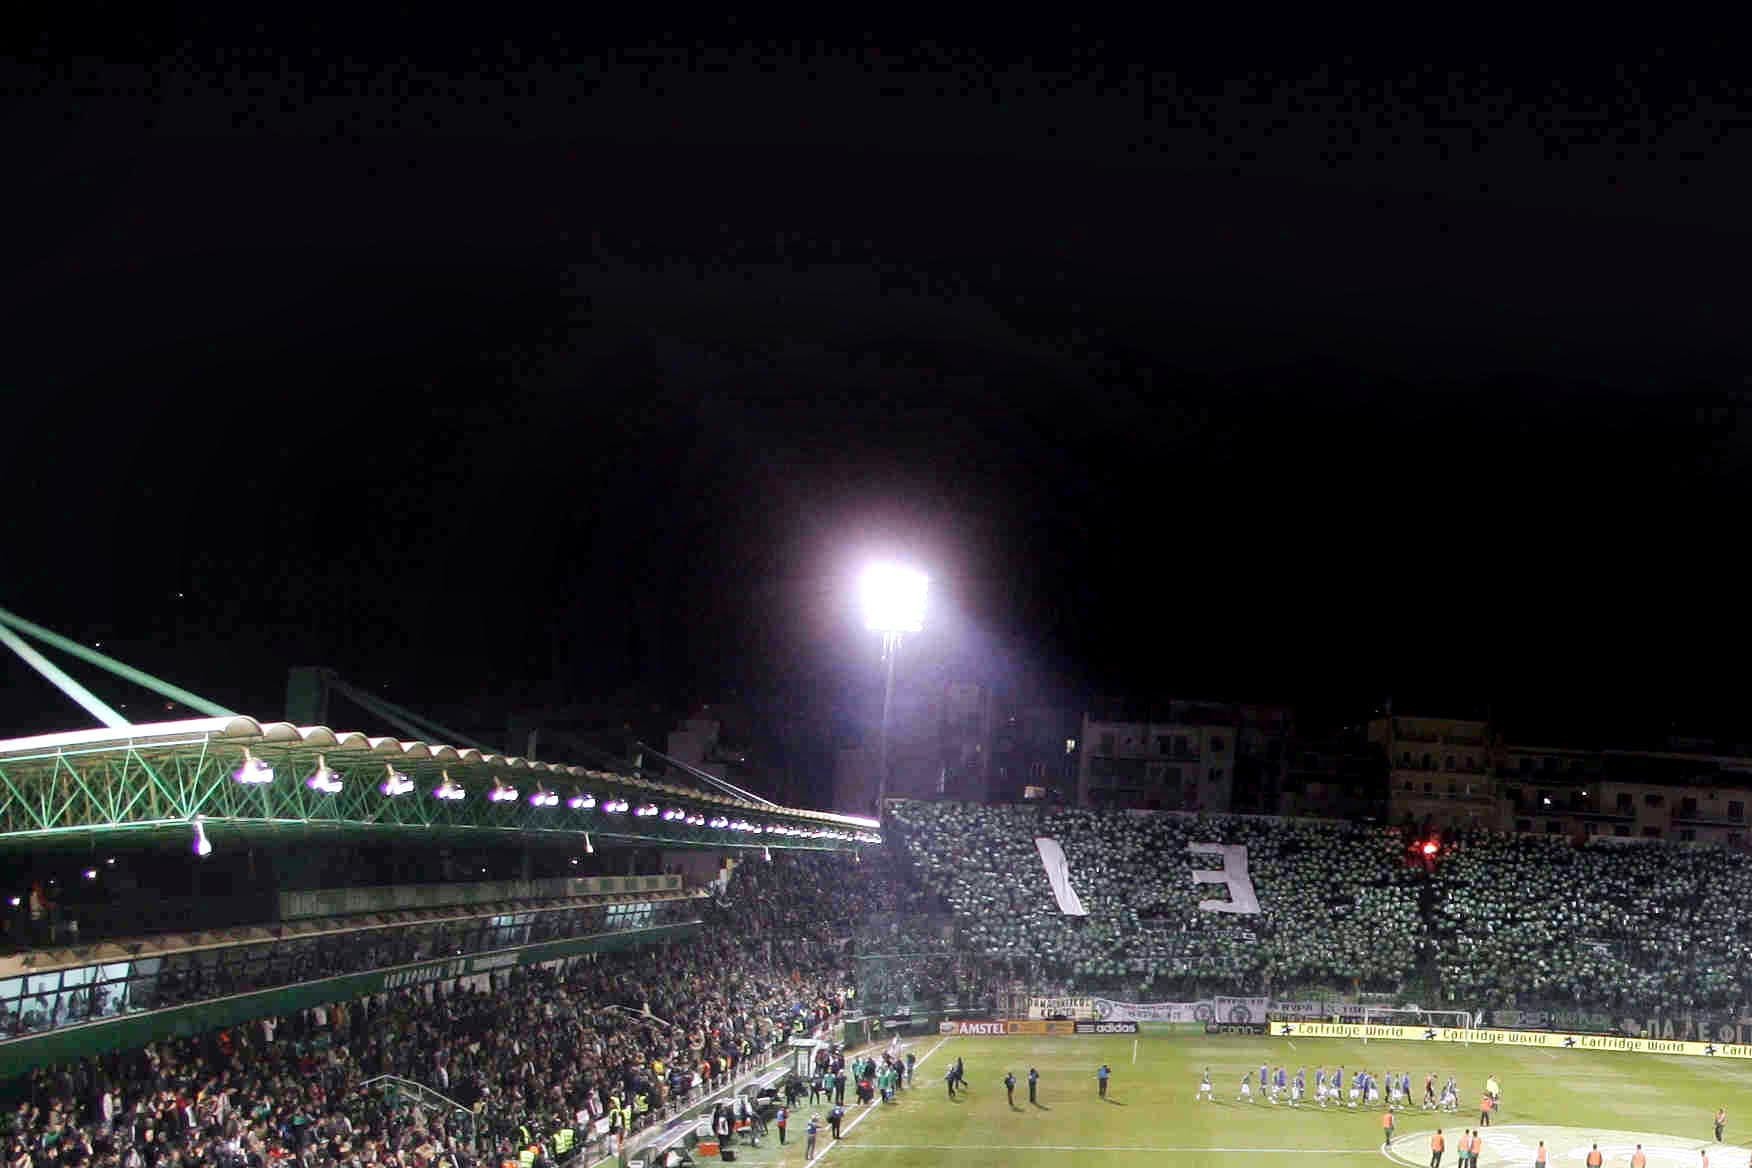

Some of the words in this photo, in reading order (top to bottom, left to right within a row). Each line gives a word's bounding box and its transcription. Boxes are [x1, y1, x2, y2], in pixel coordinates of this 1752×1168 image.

[959, 1023, 1006, 1034] AMSTEL
[1096, 1023, 1136, 1033] adidas
[1298, 1023, 1360, 1037] Cartridge
[1365, 1025, 1404, 1038] World
[1508, 1032, 1547, 1045] World
[1581, 1036, 1641, 1051] Cartridge
[1648, 1040, 1685, 1053] World
